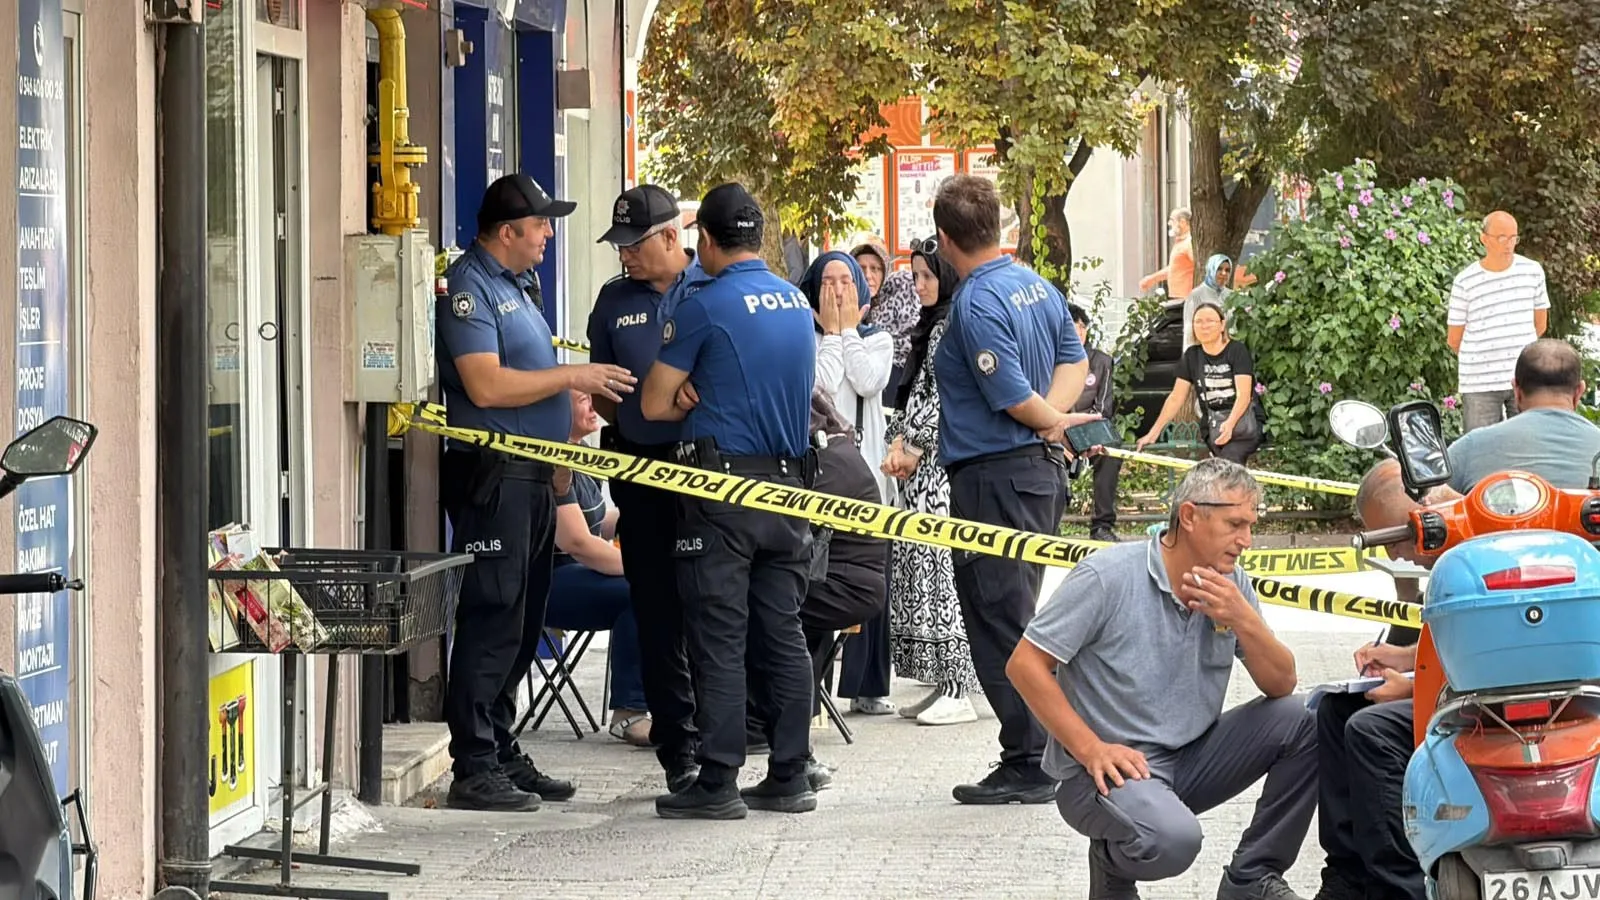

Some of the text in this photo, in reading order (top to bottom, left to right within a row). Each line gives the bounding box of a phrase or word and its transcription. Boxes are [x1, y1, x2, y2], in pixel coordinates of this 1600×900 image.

[19, 122, 54, 151] ELEKTRİK
[20, 226, 55, 249] ANAHTAR
[20, 261, 46, 290] TESLİM
[19, 302, 41, 338] İŞLER
[616, 312, 648, 329] POLIS
[18, 366, 45, 391] PROJE
[18, 406, 44, 432] DOSYA
[648, 466, 729, 493] POLİS
[18, 504, 57, 533] ÖZEL HAT
[754, 485, 881, 524] GİRİLMEZ
[675, 537, 703, 552] POLIS
[916, 517, 997, 548] POLİS
[465, 539, 502, 556] POLIS
[19, 642, 55, 675] MONTAJI
[32, 700, 63, 729] RTMAN
[1490, 877, 1530, 900] 26
